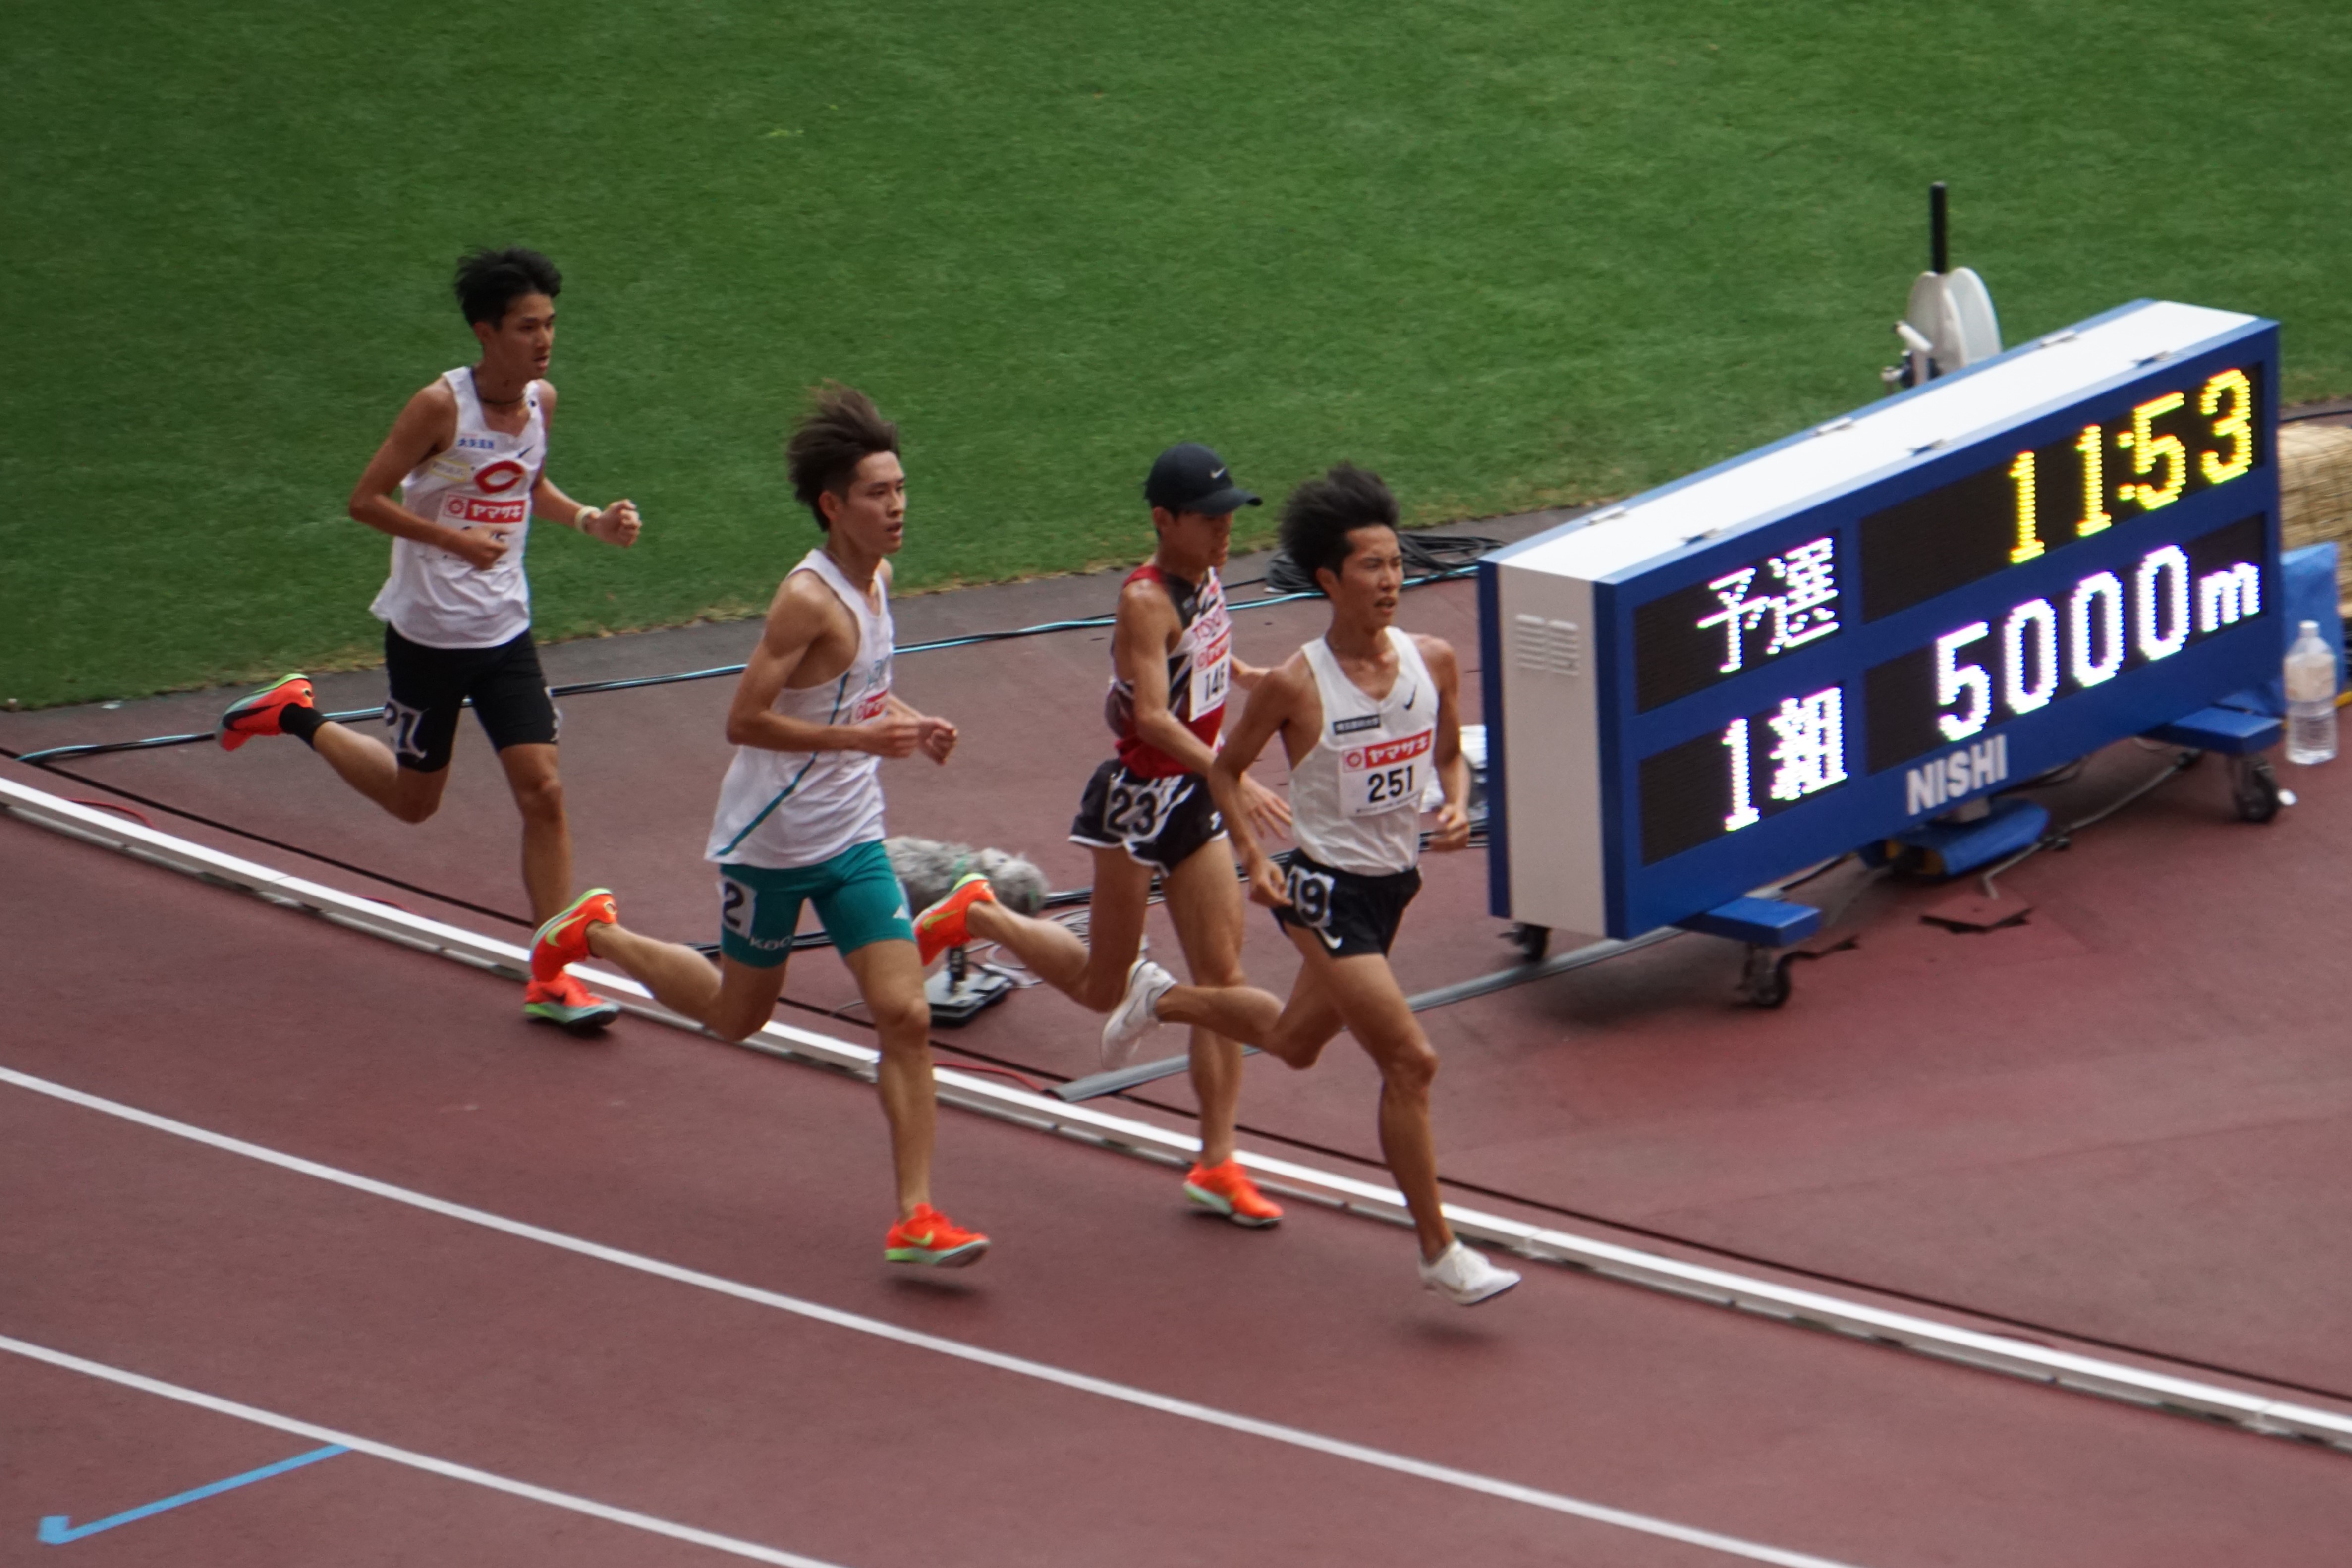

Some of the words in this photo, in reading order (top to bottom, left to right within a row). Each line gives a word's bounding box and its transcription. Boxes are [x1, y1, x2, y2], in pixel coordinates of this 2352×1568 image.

[2008, 368, 2253, 564] 11:53
[1696, 536, 1841, 673] 予選
[1936, 544, 2262, 742] 5000m
[1367, 765, 1414, 804] 251
[1368, 735, 1429, 764] ヤマザキ
[1906, 734, 2009, 817] NISHI
[1107, 787, 1157, 836] 23
